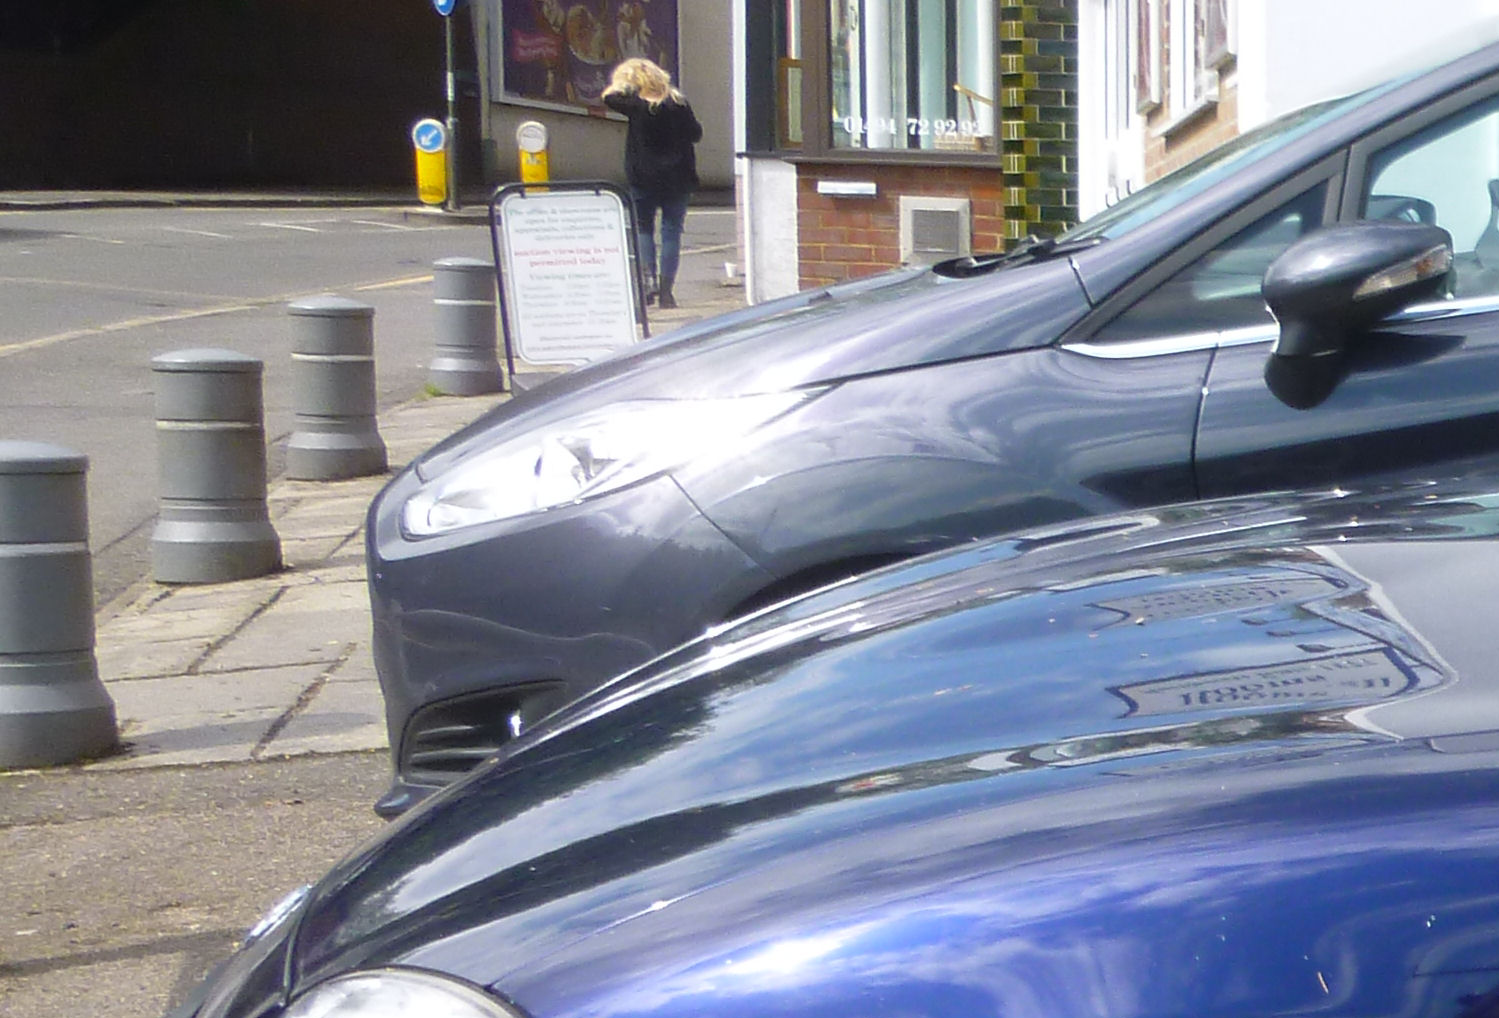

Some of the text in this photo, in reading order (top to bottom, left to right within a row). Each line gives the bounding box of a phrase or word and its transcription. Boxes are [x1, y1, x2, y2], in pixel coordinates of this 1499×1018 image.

[907, 118, 930, 136] 72
[934, 119, 957, 137] 92
[593, 246, 602, 254] is
